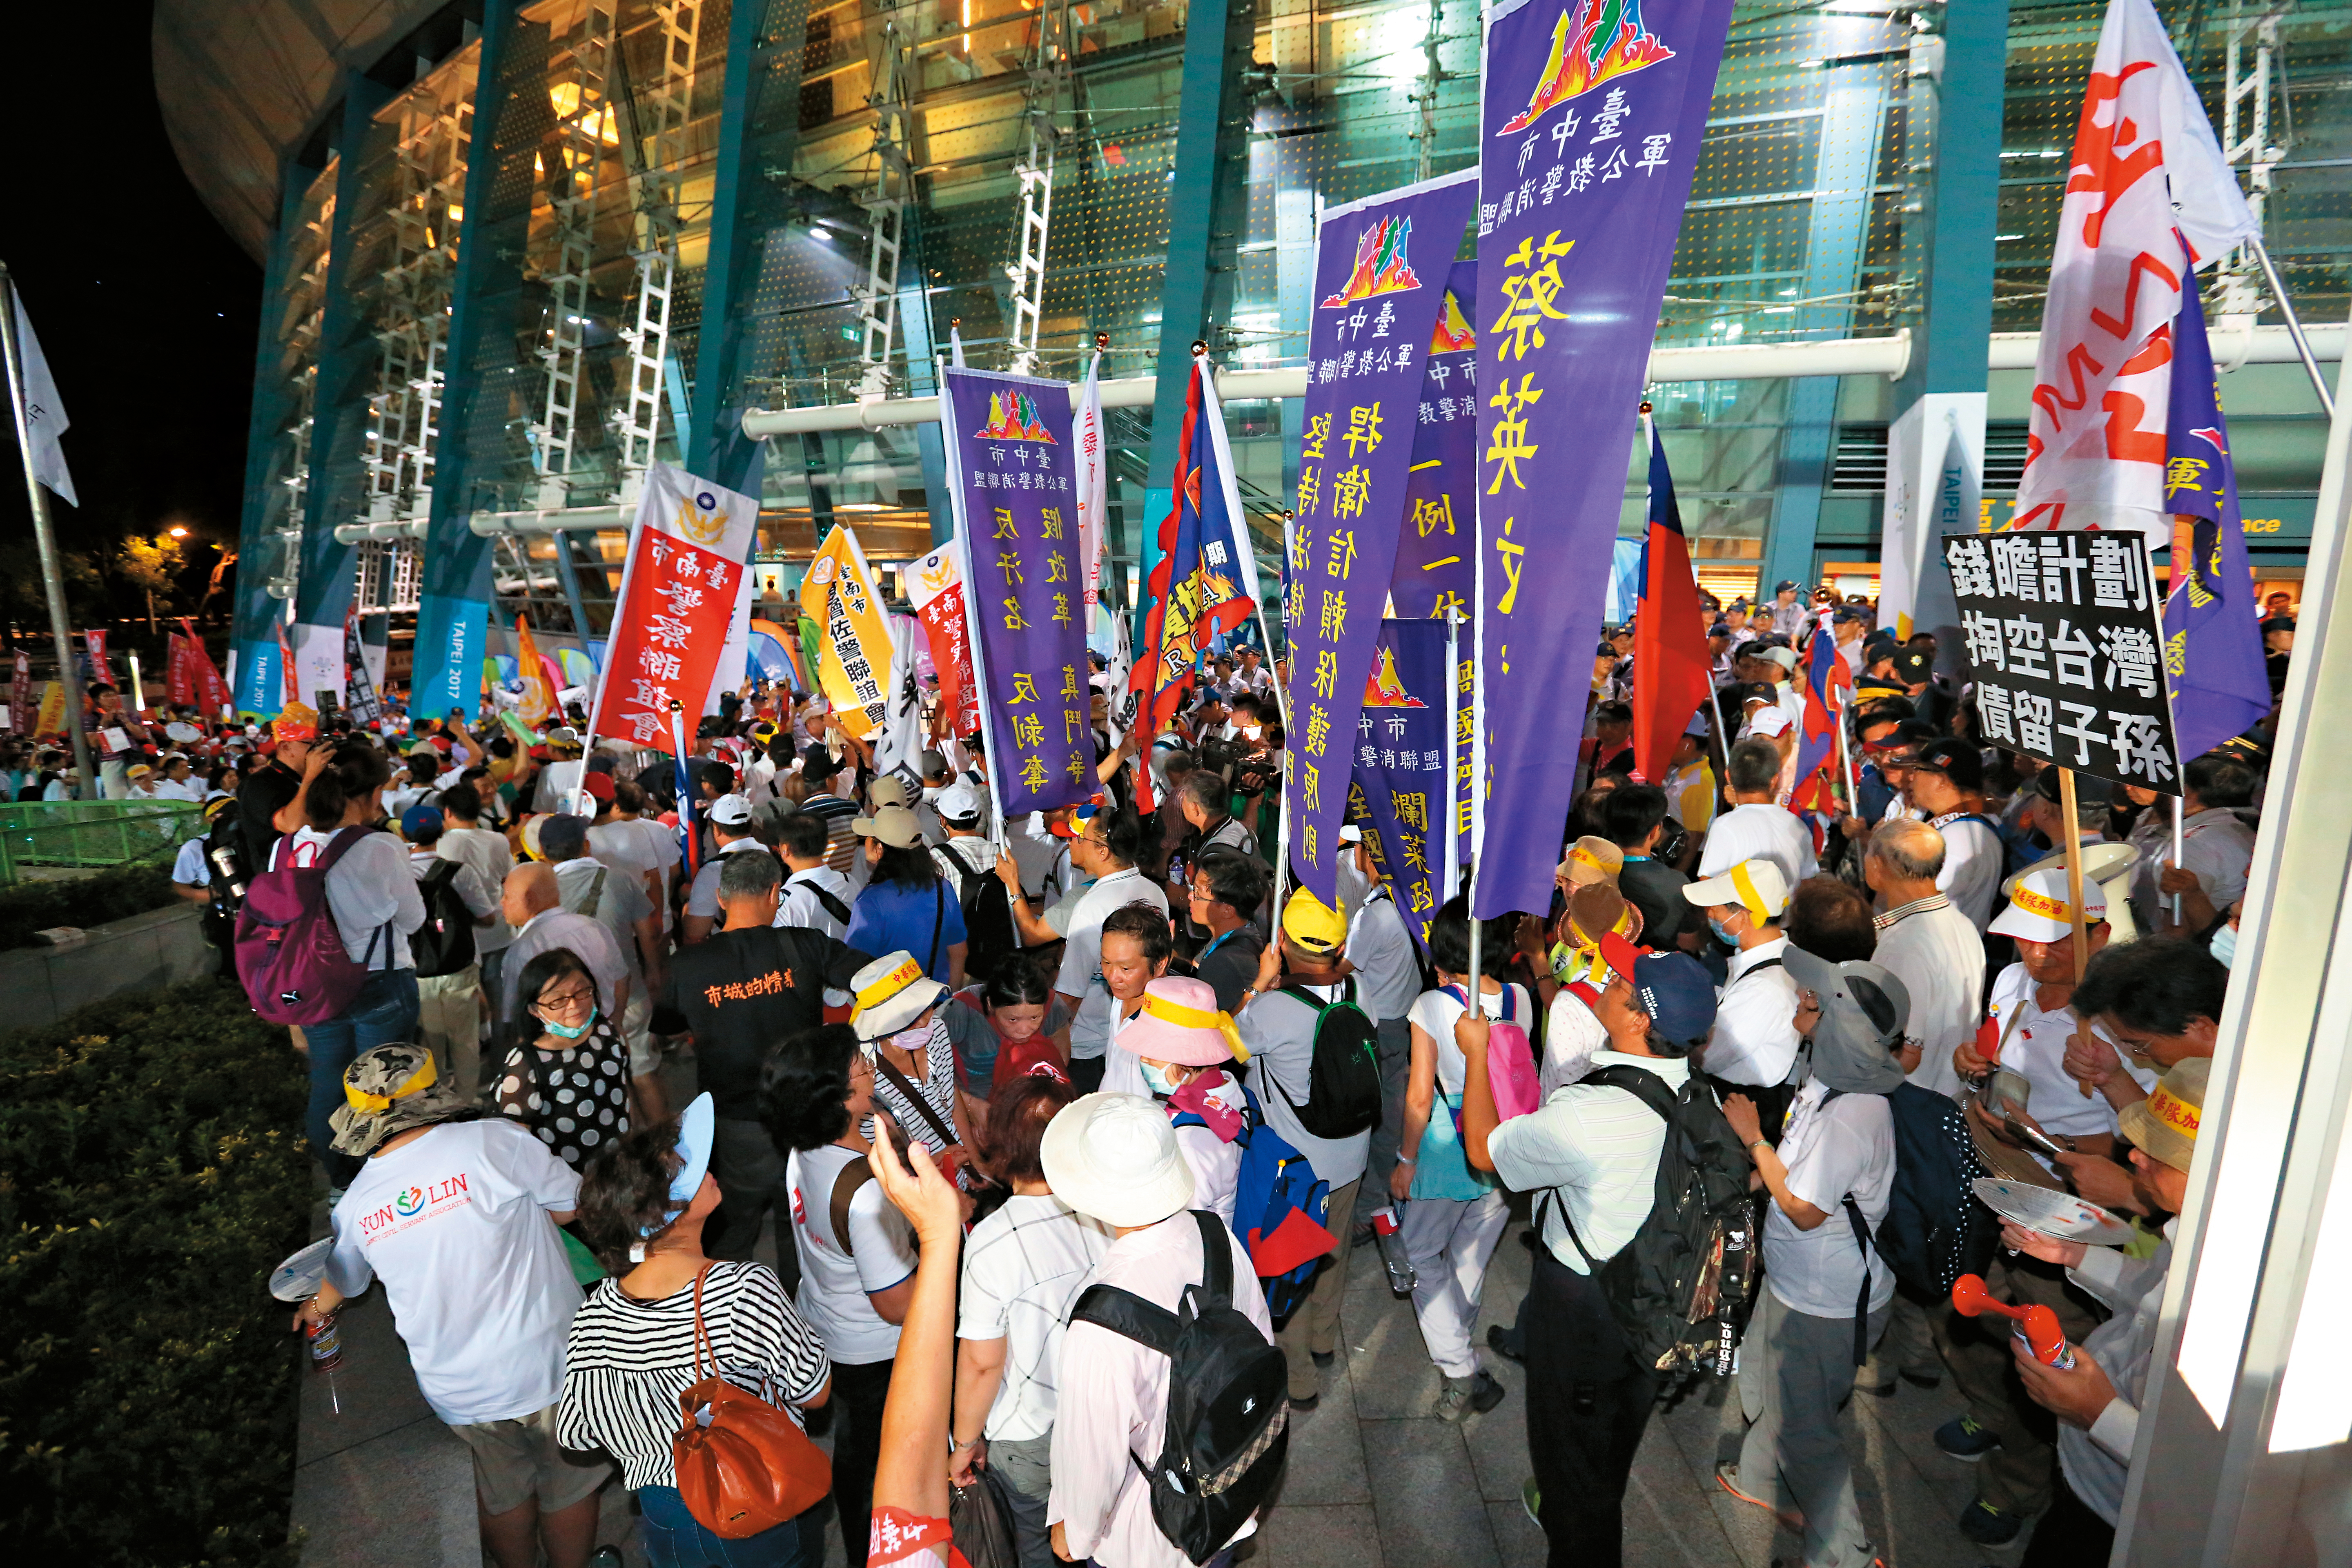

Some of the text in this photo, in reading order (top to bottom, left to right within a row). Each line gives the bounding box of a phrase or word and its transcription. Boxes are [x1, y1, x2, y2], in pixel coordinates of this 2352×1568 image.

[1942, 466, 1962, 523] TAIPEI
[1946, 535, 2148, 612] 錢瞻計劃
[256, 656, 267, 684] TAIPEI
[448, 621, 466, 699] TAIPEI 2017
[1962, 610, 2158, 699] 掏空台灣
[1352, 745, 1442, 772] 警消聯盟
[1976, 680, 2174, 783] 債留子孫
[359, 1173, 468, 1235] YUN LIN
[400, 1214, 427, 1230] SERVANT
[429, 1197, 471, 1218] ASSOCIATION
